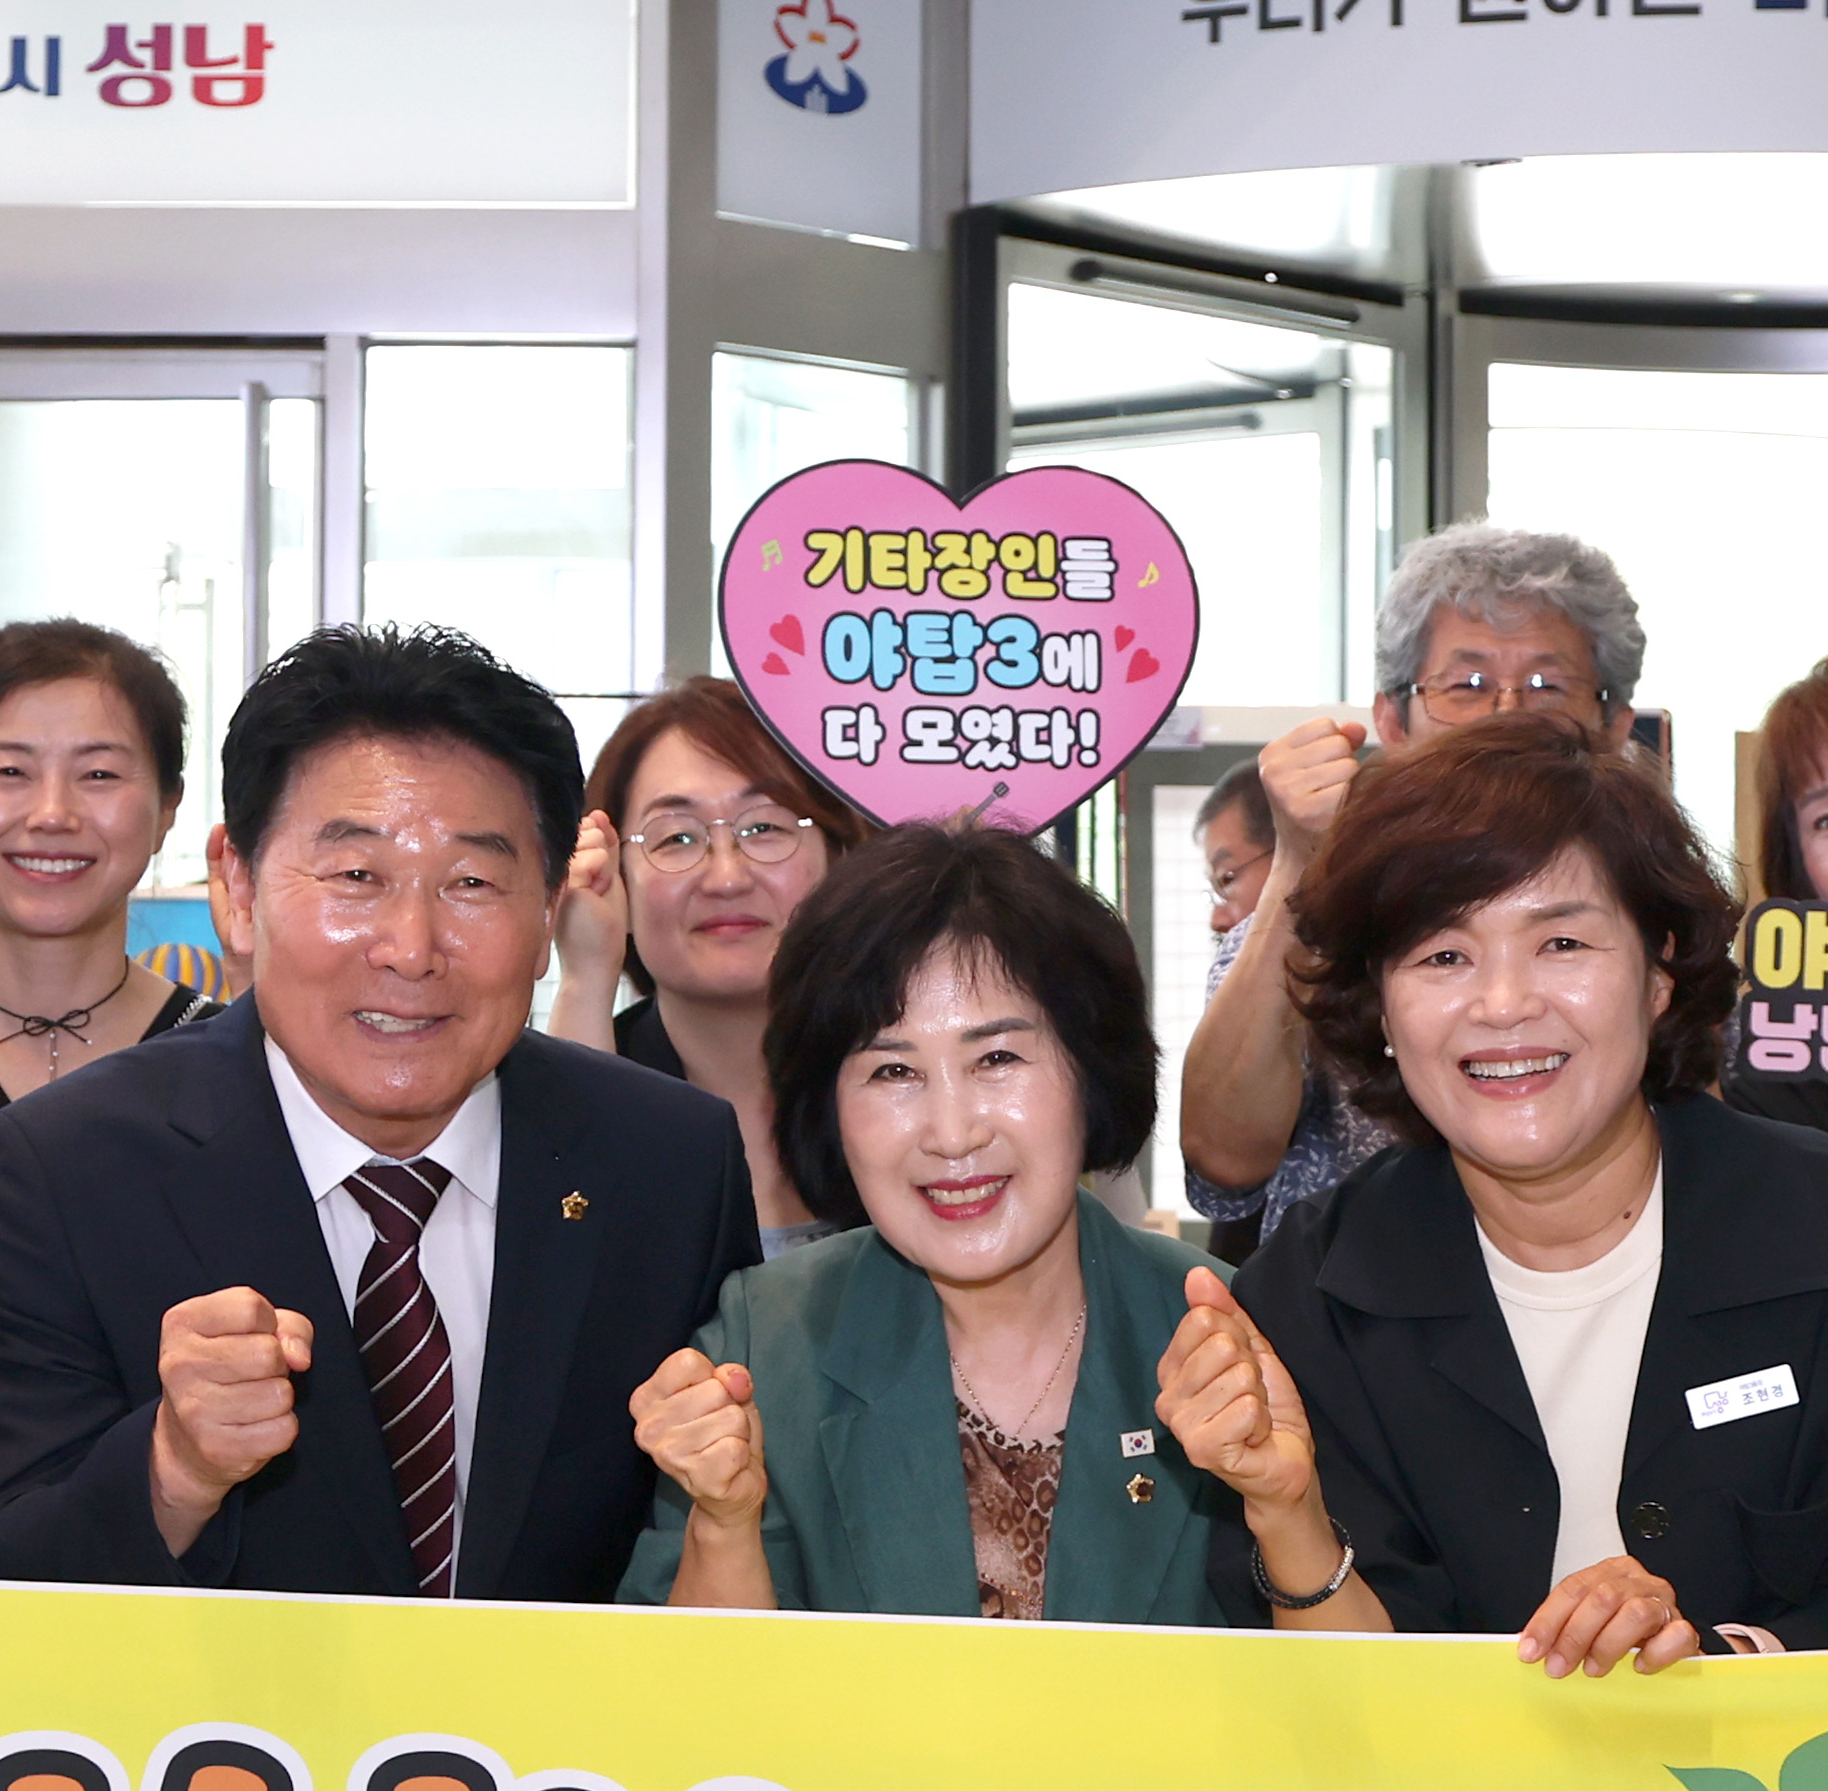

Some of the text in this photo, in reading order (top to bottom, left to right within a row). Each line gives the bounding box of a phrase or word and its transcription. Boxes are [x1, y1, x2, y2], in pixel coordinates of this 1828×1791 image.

[85, 22, 275, 107] 성남
[804, 527, 1118, 602] 기타장인들
[821, 608, 1102, 697] 야탑3에
[822, 703, 886, 767] 다
[900, 705, 1101, 771] 모였다!
